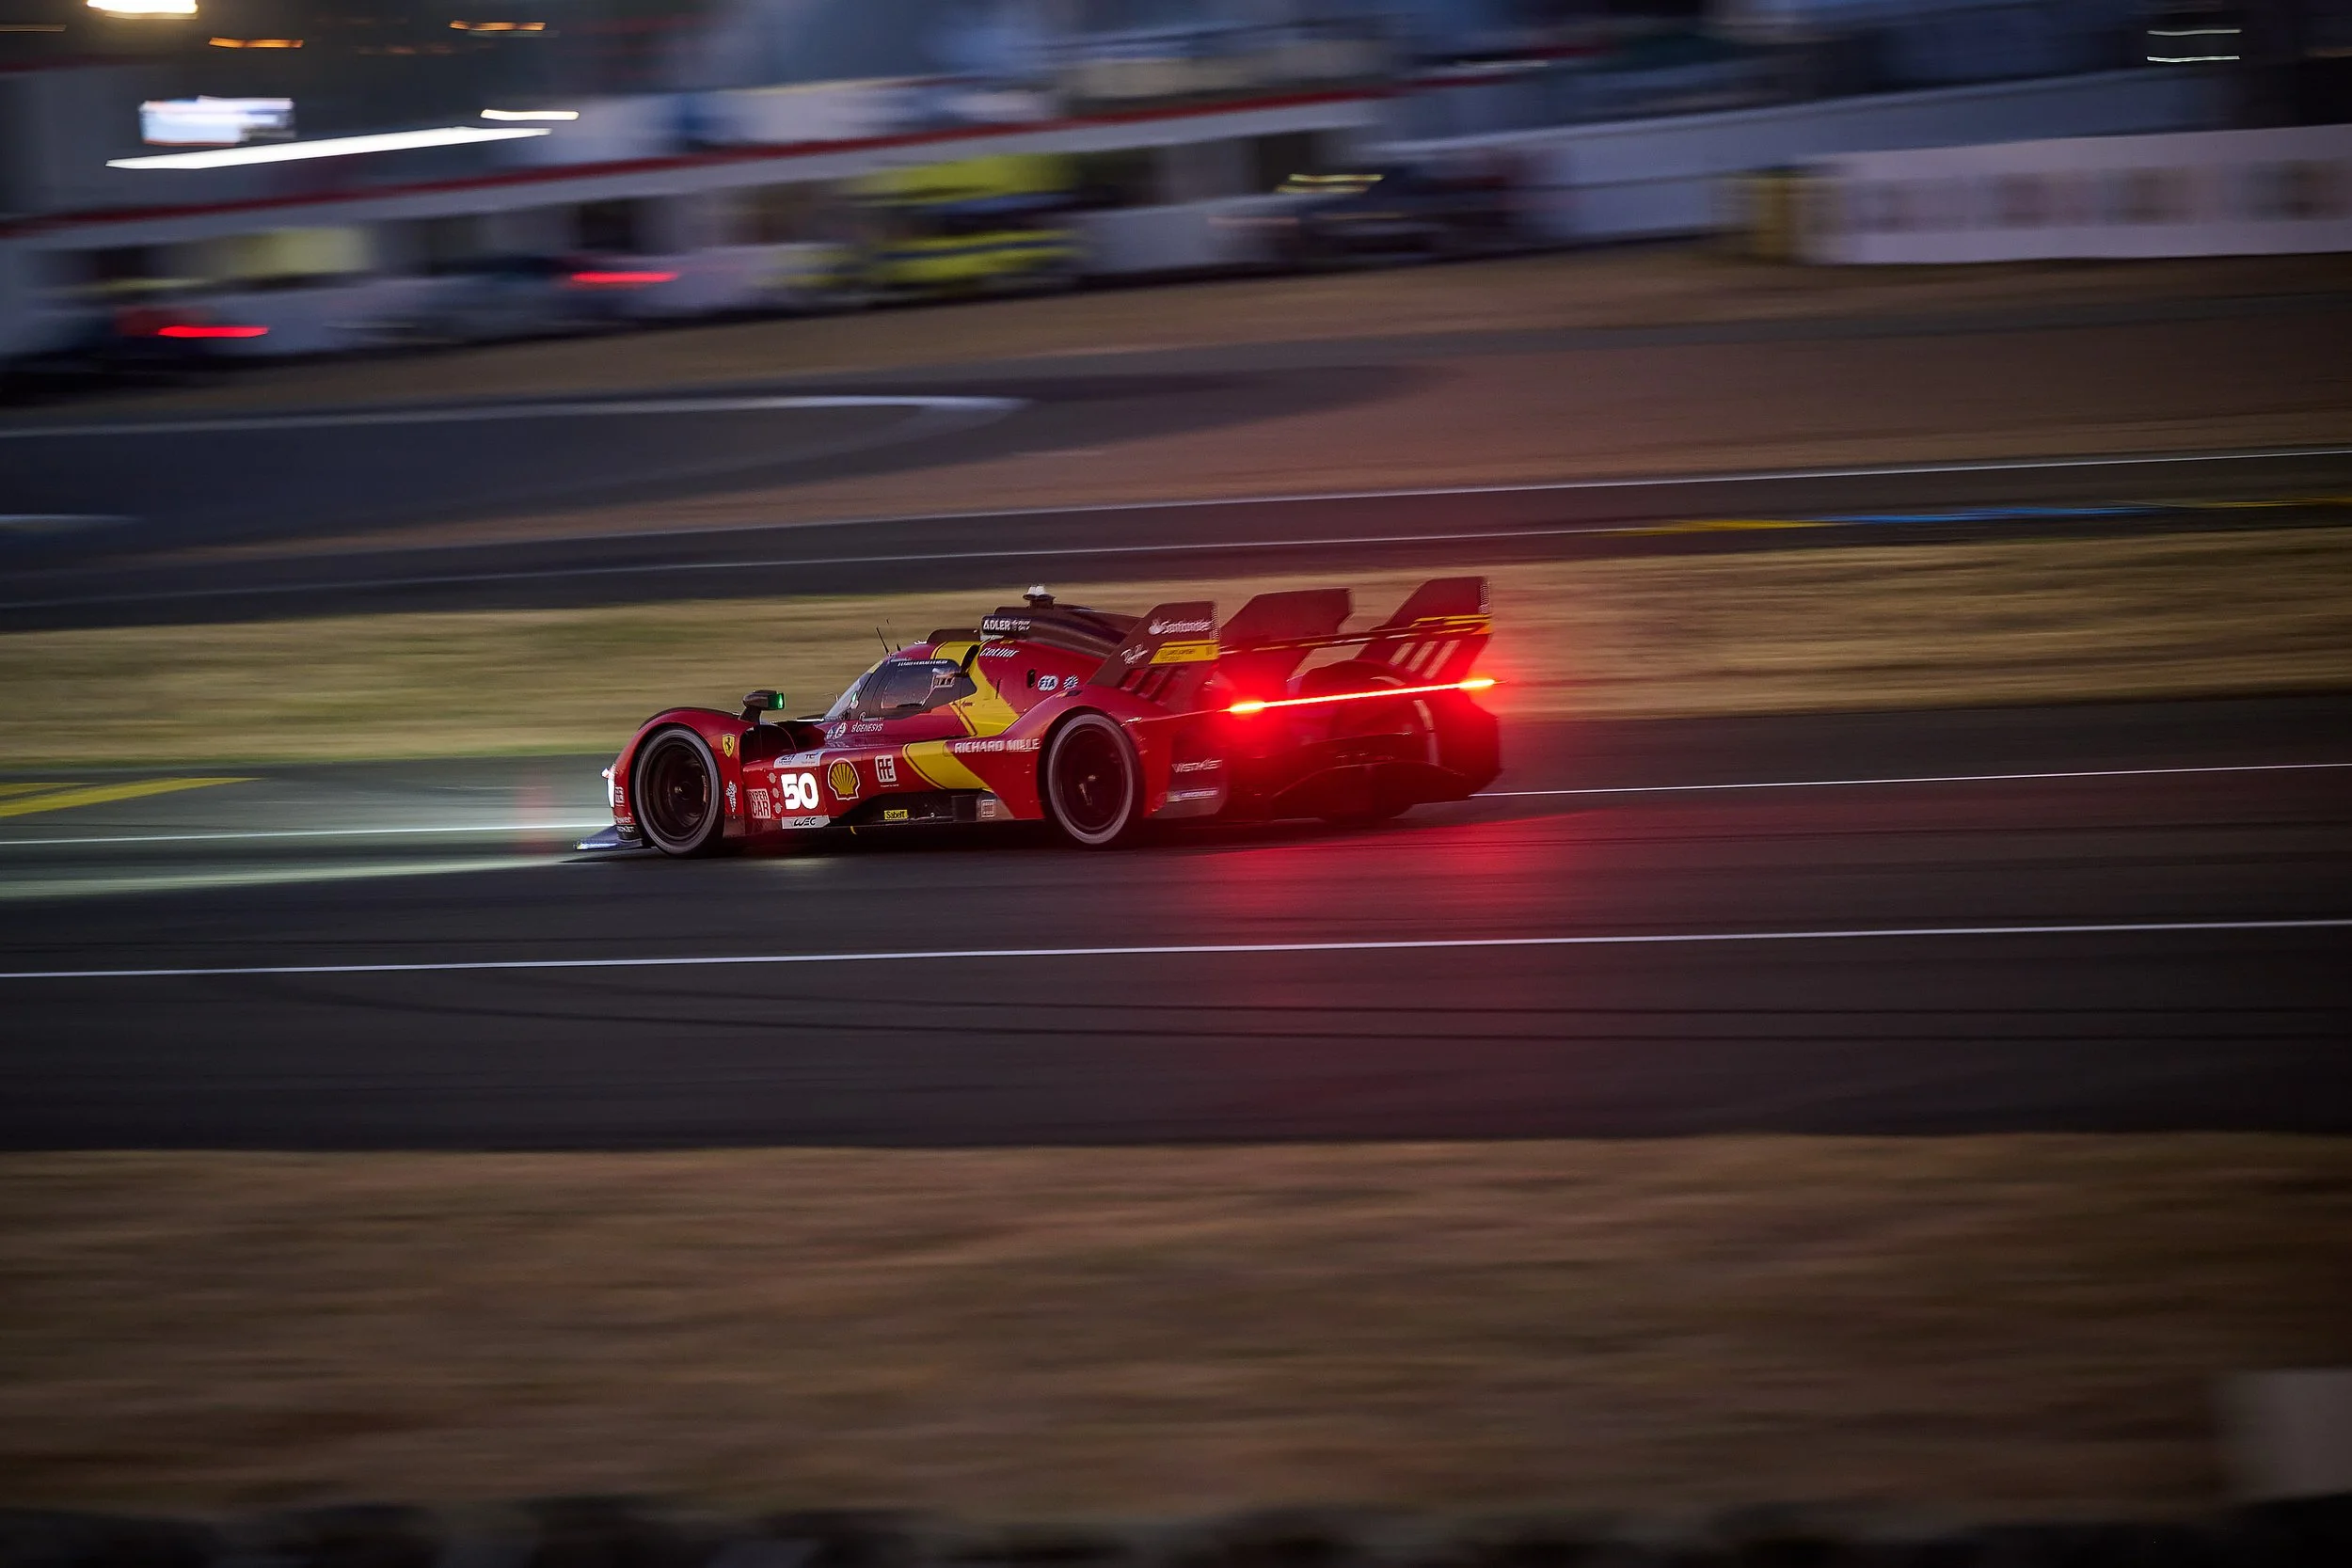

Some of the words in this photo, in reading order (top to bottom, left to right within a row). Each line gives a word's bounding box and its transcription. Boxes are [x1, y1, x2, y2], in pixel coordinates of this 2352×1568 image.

[983, 619, 1010, 631] ADLER
[955, 740, 1004, 753] RICHARD
[1006, 738, 1041, 752] MILLE
[780, 772, 819, 810] 50
[751, 800, 770, 816] CAR
[886, 811, 905, 819] Sabelt
[793, 817, 817, 827] WEC
